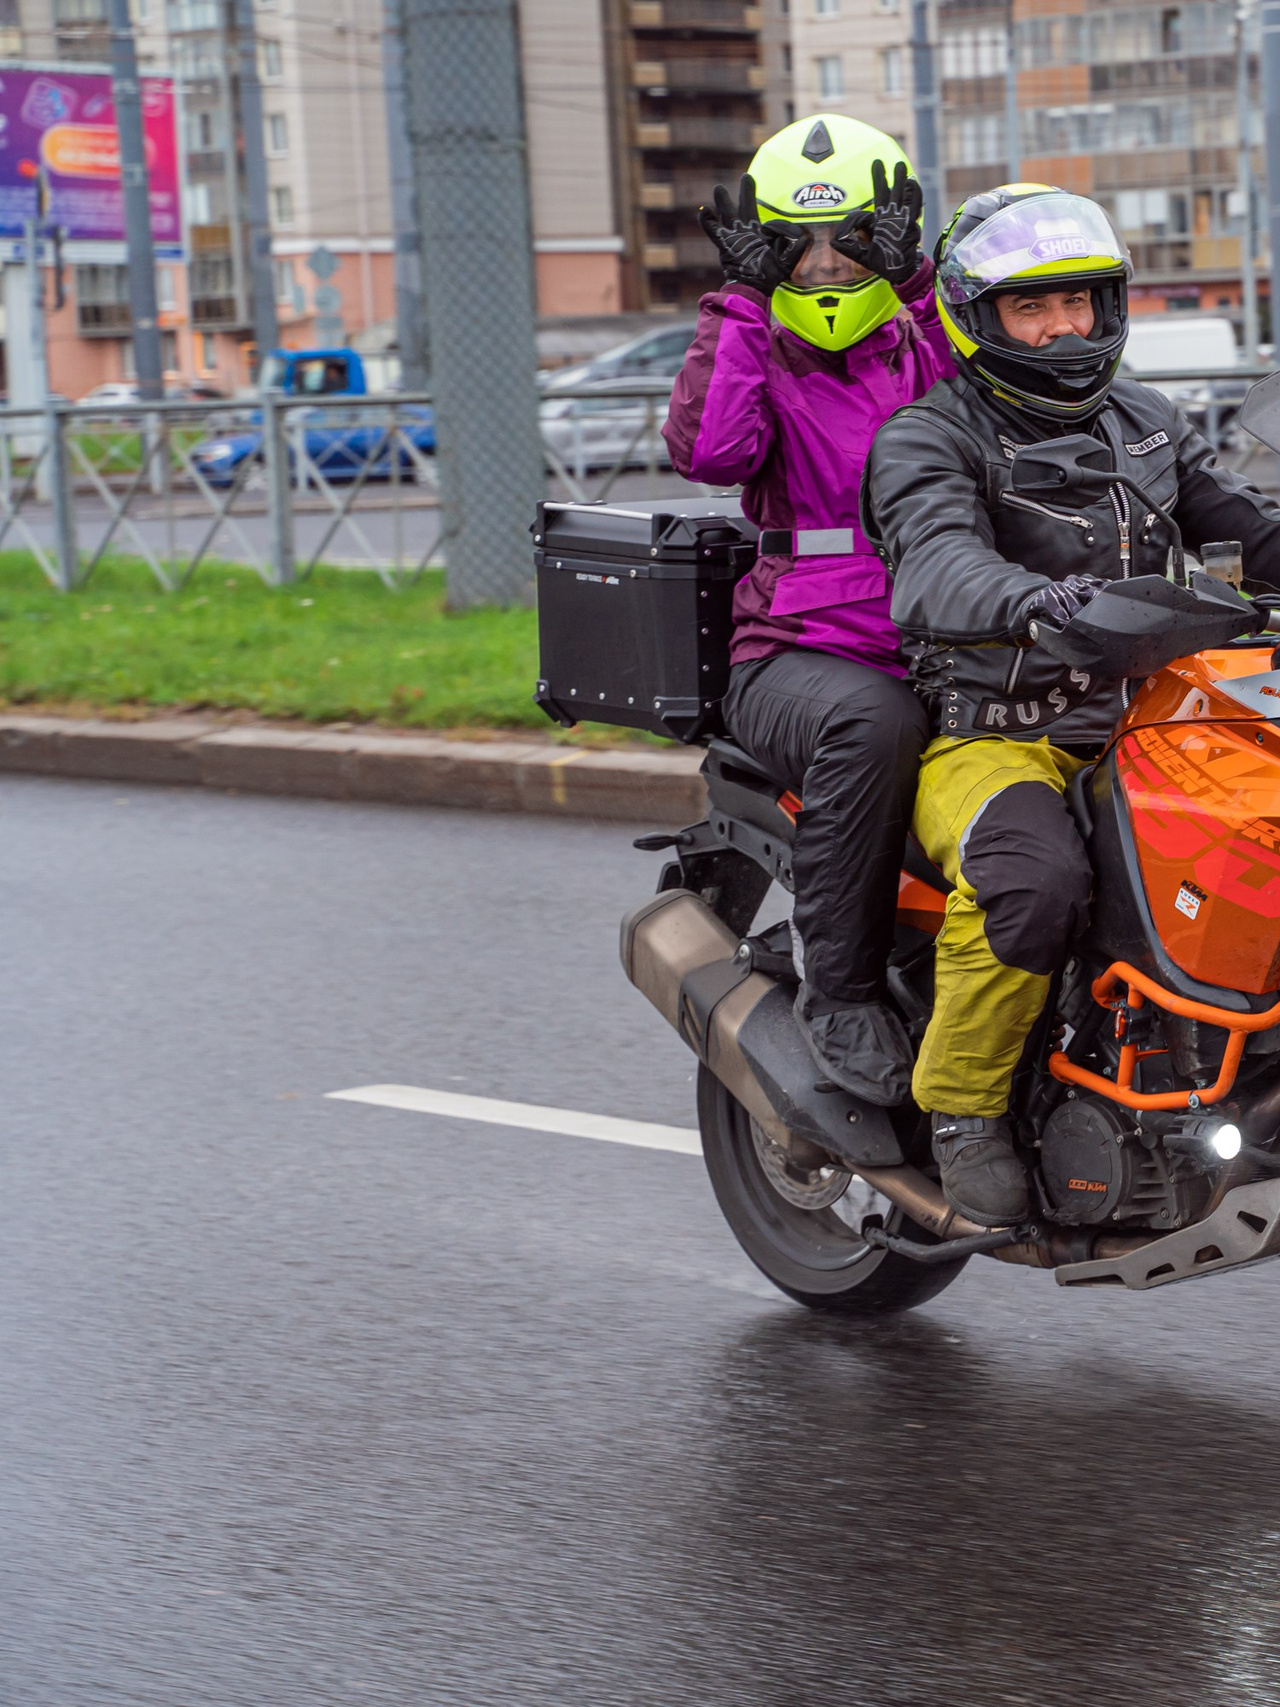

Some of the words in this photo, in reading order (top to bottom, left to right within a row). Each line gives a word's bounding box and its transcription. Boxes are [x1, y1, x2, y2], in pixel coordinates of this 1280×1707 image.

[795, 185, 844, 203] Airoh
[1038, 238, 1086, 258] SHOEI
[1127, 434, 1167, 453] MEMBER
[985, 668, 1091, 728] RUSS
[1181, 879, 1208, 902] KTM
